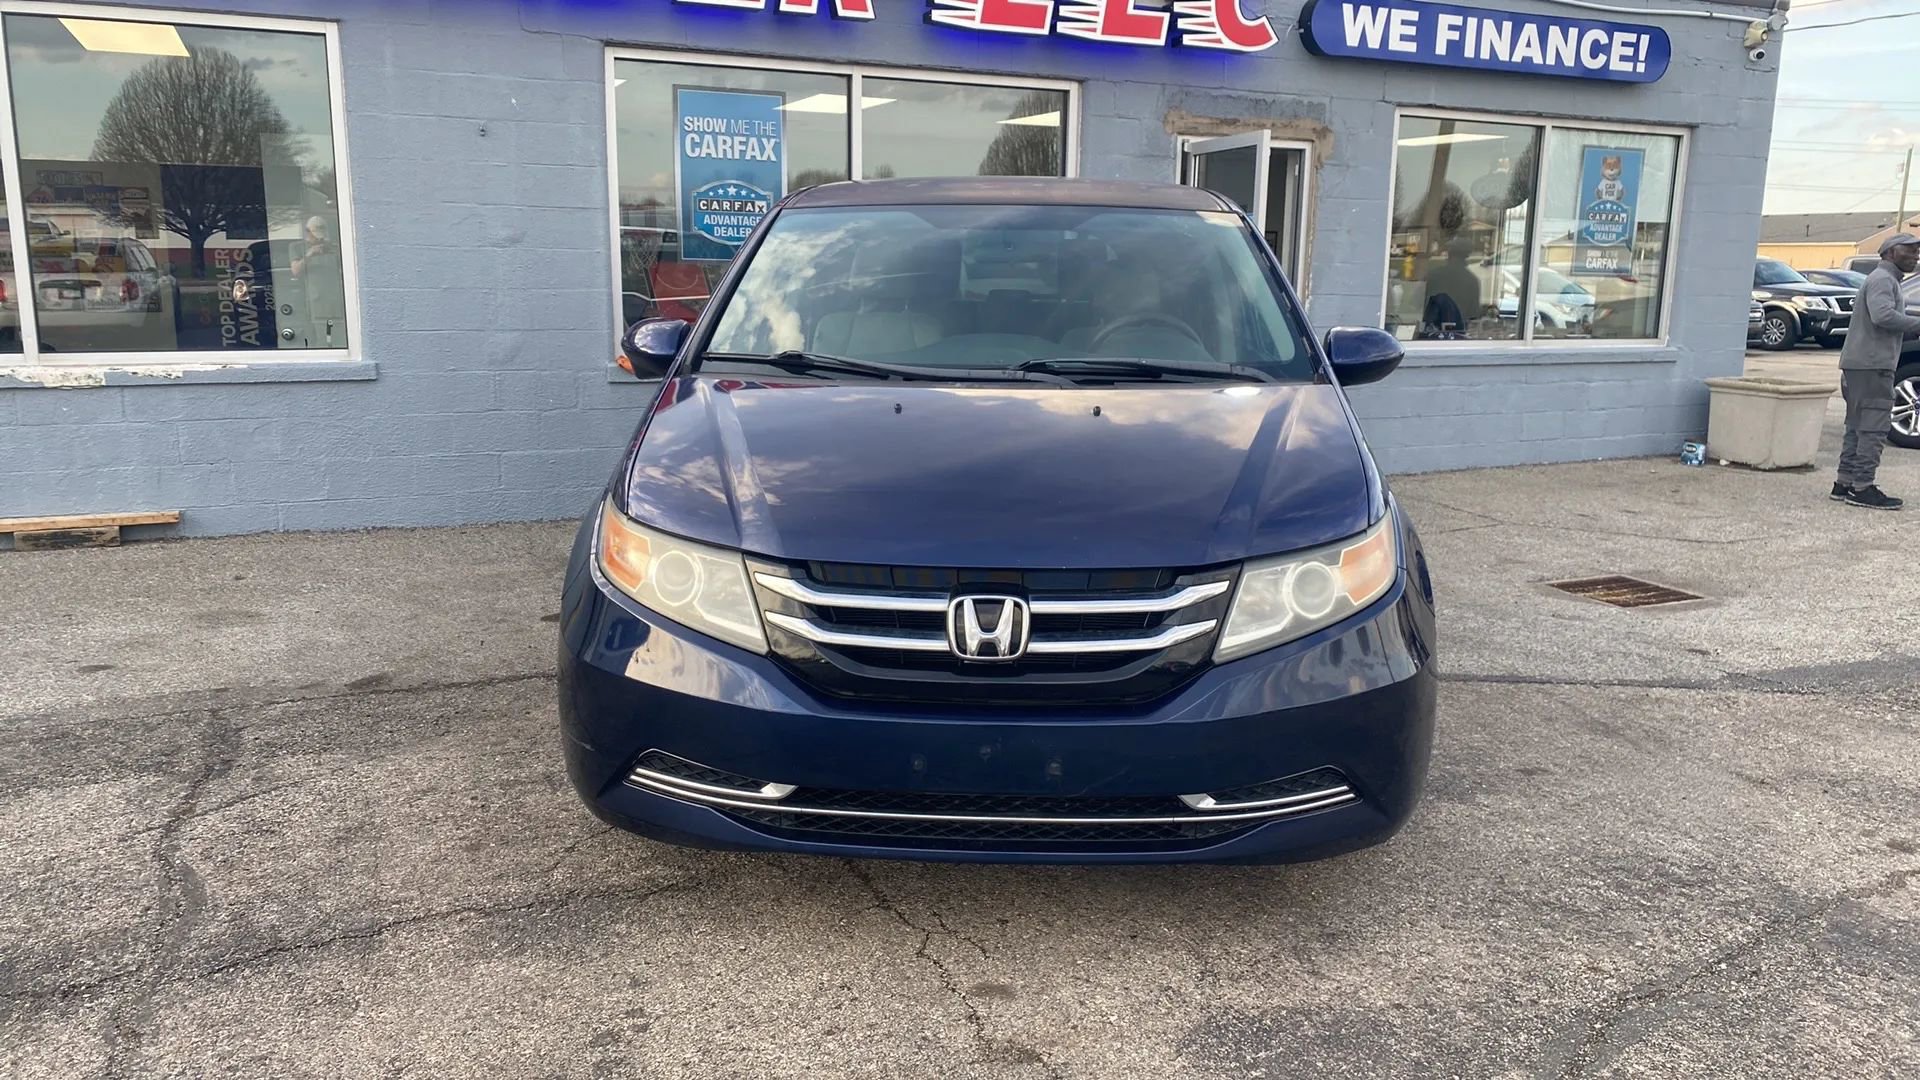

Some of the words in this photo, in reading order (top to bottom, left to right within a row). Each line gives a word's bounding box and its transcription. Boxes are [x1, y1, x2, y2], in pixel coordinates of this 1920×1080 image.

[1342, 3, 1420, 53] WE
[1435, 13, 1650, 73] FINANCE!
[684, 116, 727, 133] SHOW
[730, 119, 750, 135] ME
[752, 120, 777, 137] THE
[685, 133, 777, 162] CARFAX
[699, 200, 767, 214] CARFAX
[1594, 232, 1617, 241] DEALER
[1586, 257, 1618, 269] CARFAX
[214, 249, 234, 313] DEALER
[221, 315, 237, 347] TOP
